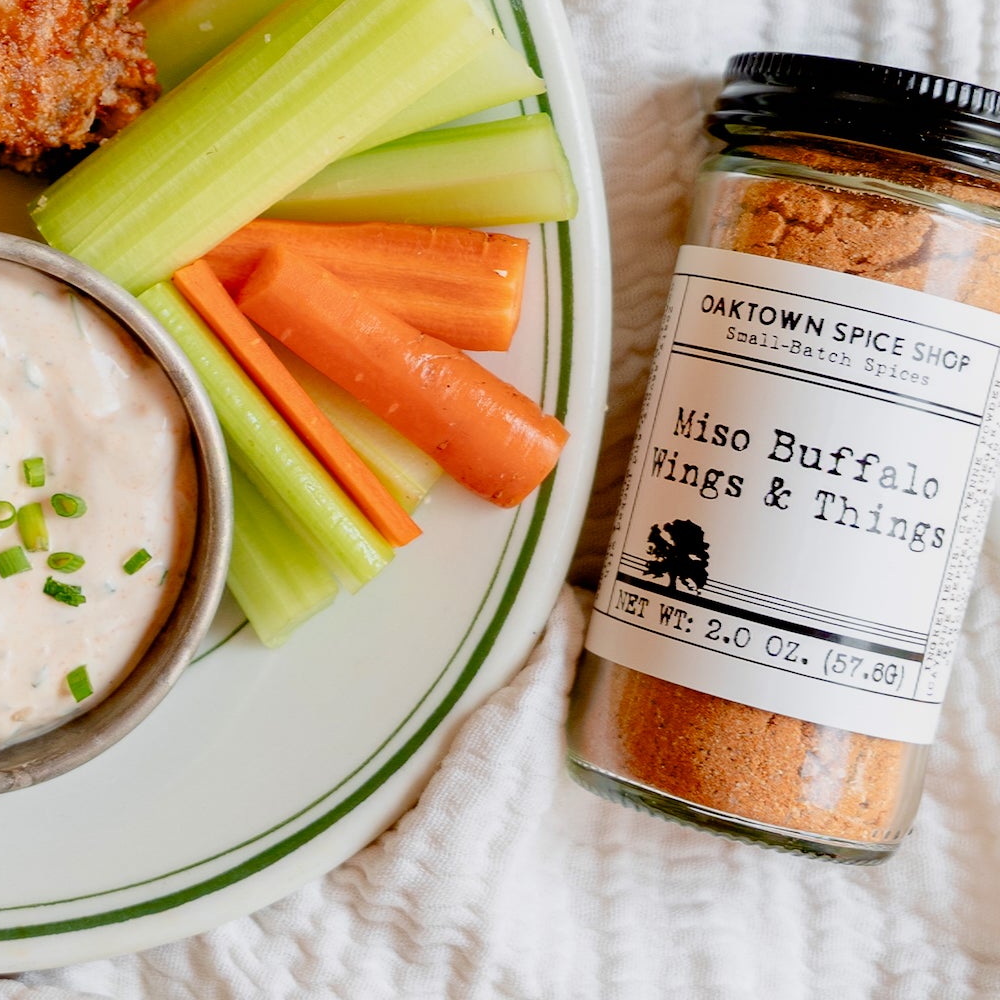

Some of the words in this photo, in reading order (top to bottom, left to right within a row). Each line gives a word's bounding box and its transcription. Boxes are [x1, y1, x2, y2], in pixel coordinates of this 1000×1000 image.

[701, 295, 825, 337] OAKTOWN
[832, 322, 906, 356] SPICE
[913, 342, 970, 373] SHOP
[726, 326, 851, 367] Small-Batch
[864, 357, 930, 386] Spices
[673, 406, 750, 451] Miso
[768, 429, 939, 500] Buffalo
[650, 447, 744, 500] Wings
[763, 476, 792, 511] &
[814, 489, 946, 553] Things
[614, 589, 650, 618] NET
[659, 603, 695, 634] WT:
[704, 618, 751, 648] 2.0
[765, 635, 808, 666] OZ.
